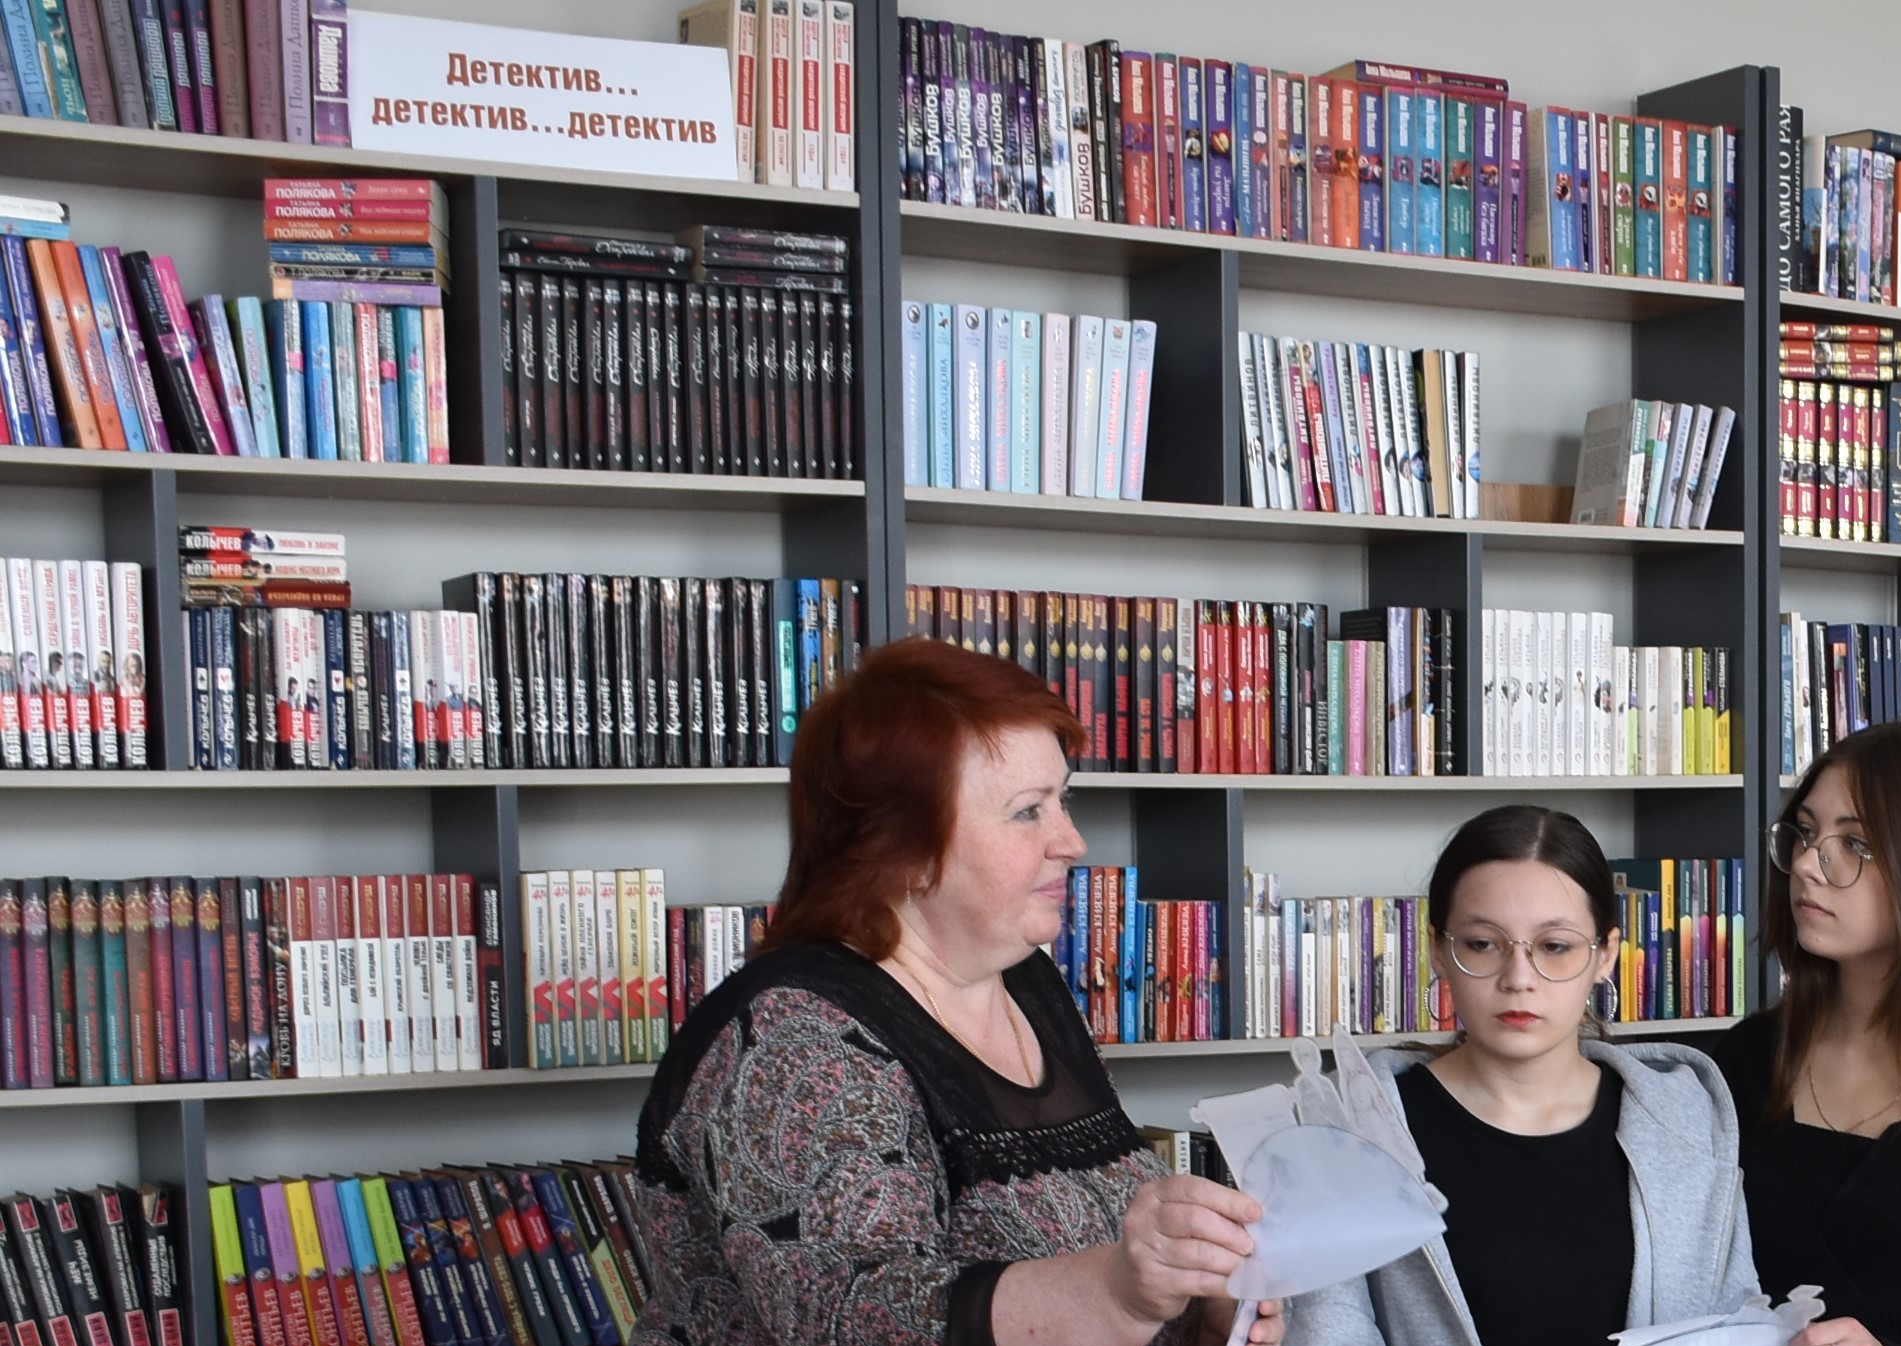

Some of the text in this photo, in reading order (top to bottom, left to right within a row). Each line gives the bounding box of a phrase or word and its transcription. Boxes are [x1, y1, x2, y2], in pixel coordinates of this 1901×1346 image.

[276, 187, 335, 199] ПОЛЯКОВА
[276, 206, 335, 218] ПОЛЯКОВА
[274, 227, 333, 240] ПОЛЯКОВА
[186, 536, 242, 550] КОЛЫЧЕВ
[186, 564, 242, 576] КОЛЫЧЕВ
[126, 570, 146, 764] КОЛЫЧЕВ ДОЧЬ АВТОРИТЕТА
[55, 698, 71, 764] КОЛЫЧЕВ
[78, 699, 93, 764] КОЛЫЧЕВ
[275, 962, 291, 1066] КРОВЬ НА ДОНУ
[491, 981, 502, 1046] ЯД ВЛАСТИ
[69, 1261, 82, 1284] МЕЧ
[74, 1239, 99, 1300] НЕМЕЗИДЫ
